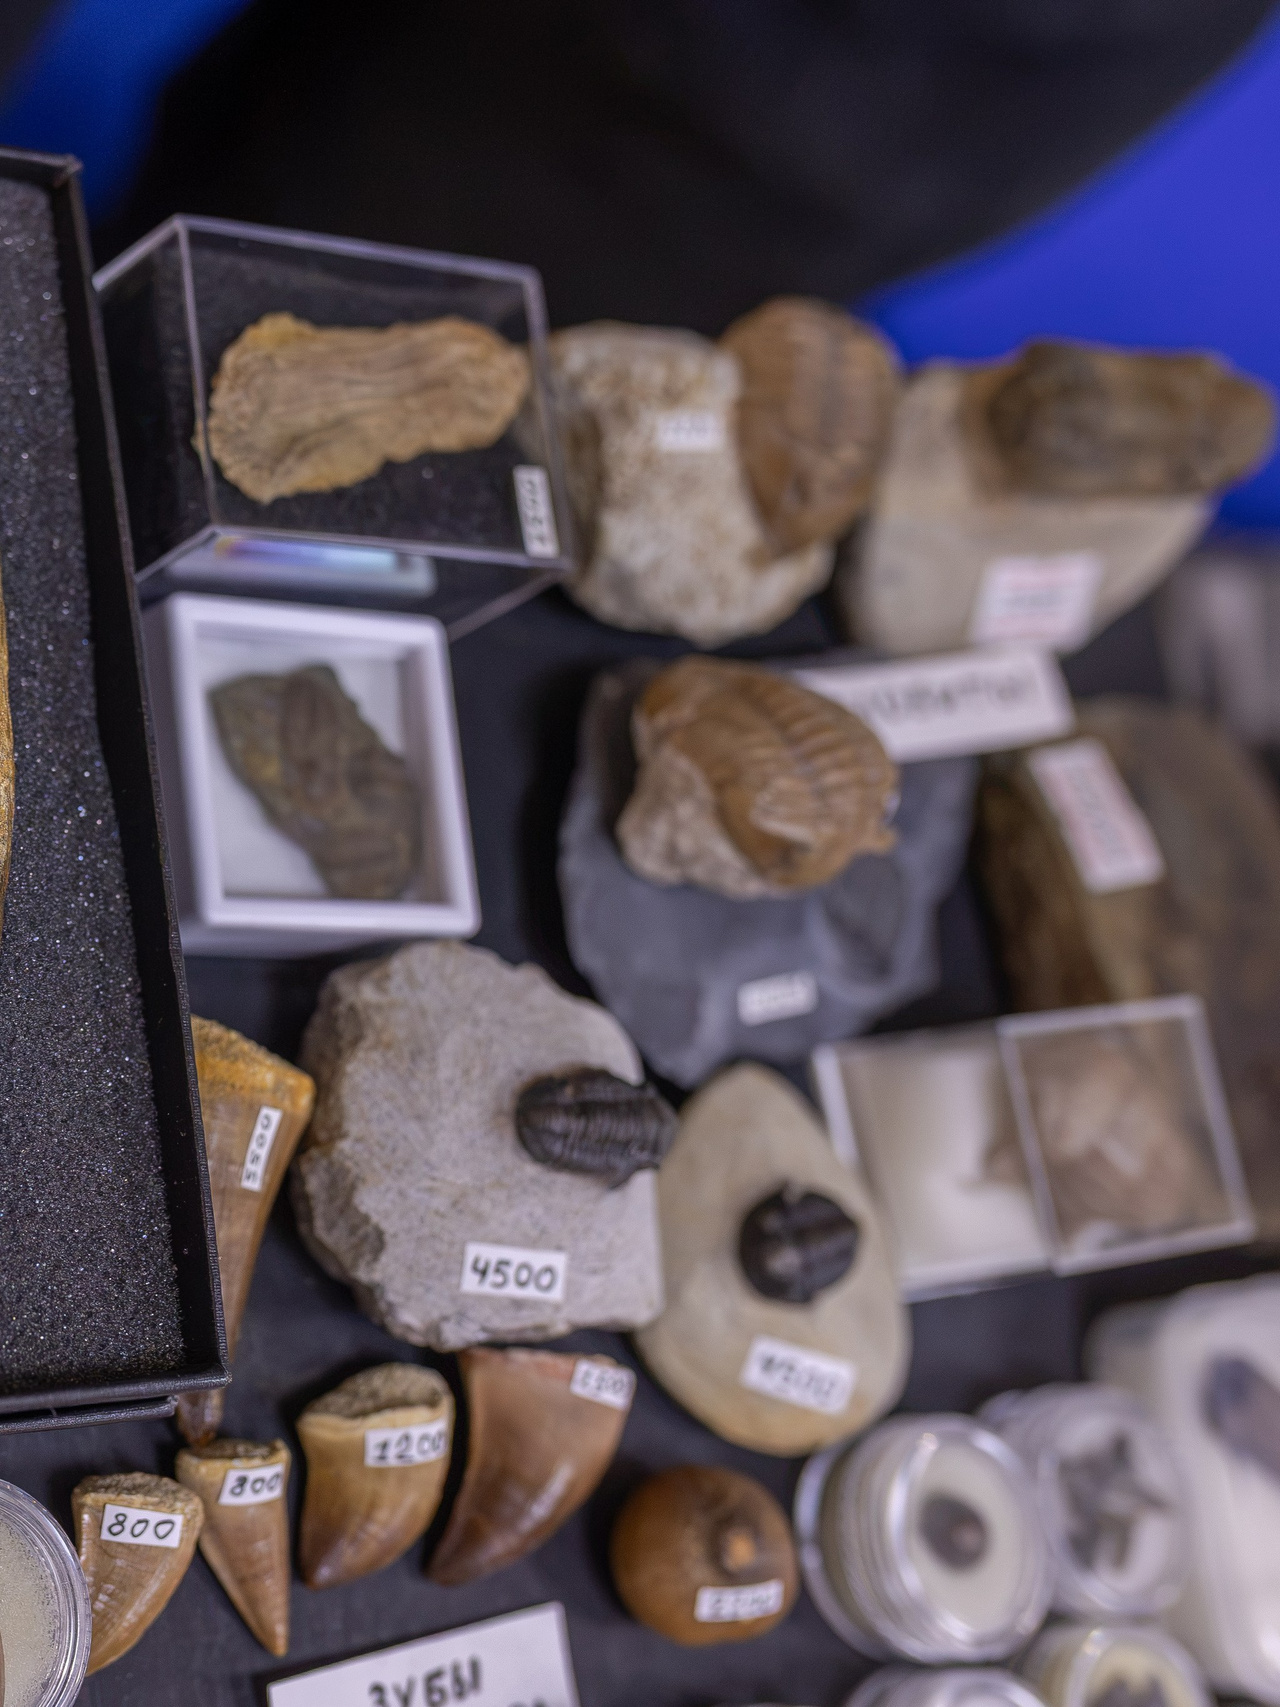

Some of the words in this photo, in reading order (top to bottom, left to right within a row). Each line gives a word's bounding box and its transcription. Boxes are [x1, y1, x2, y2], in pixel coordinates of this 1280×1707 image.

[471, 1255, 558, 1293] 4500
[229, 1471, 281, 1497] 800
[107, 1512, 176, 1540] 800
